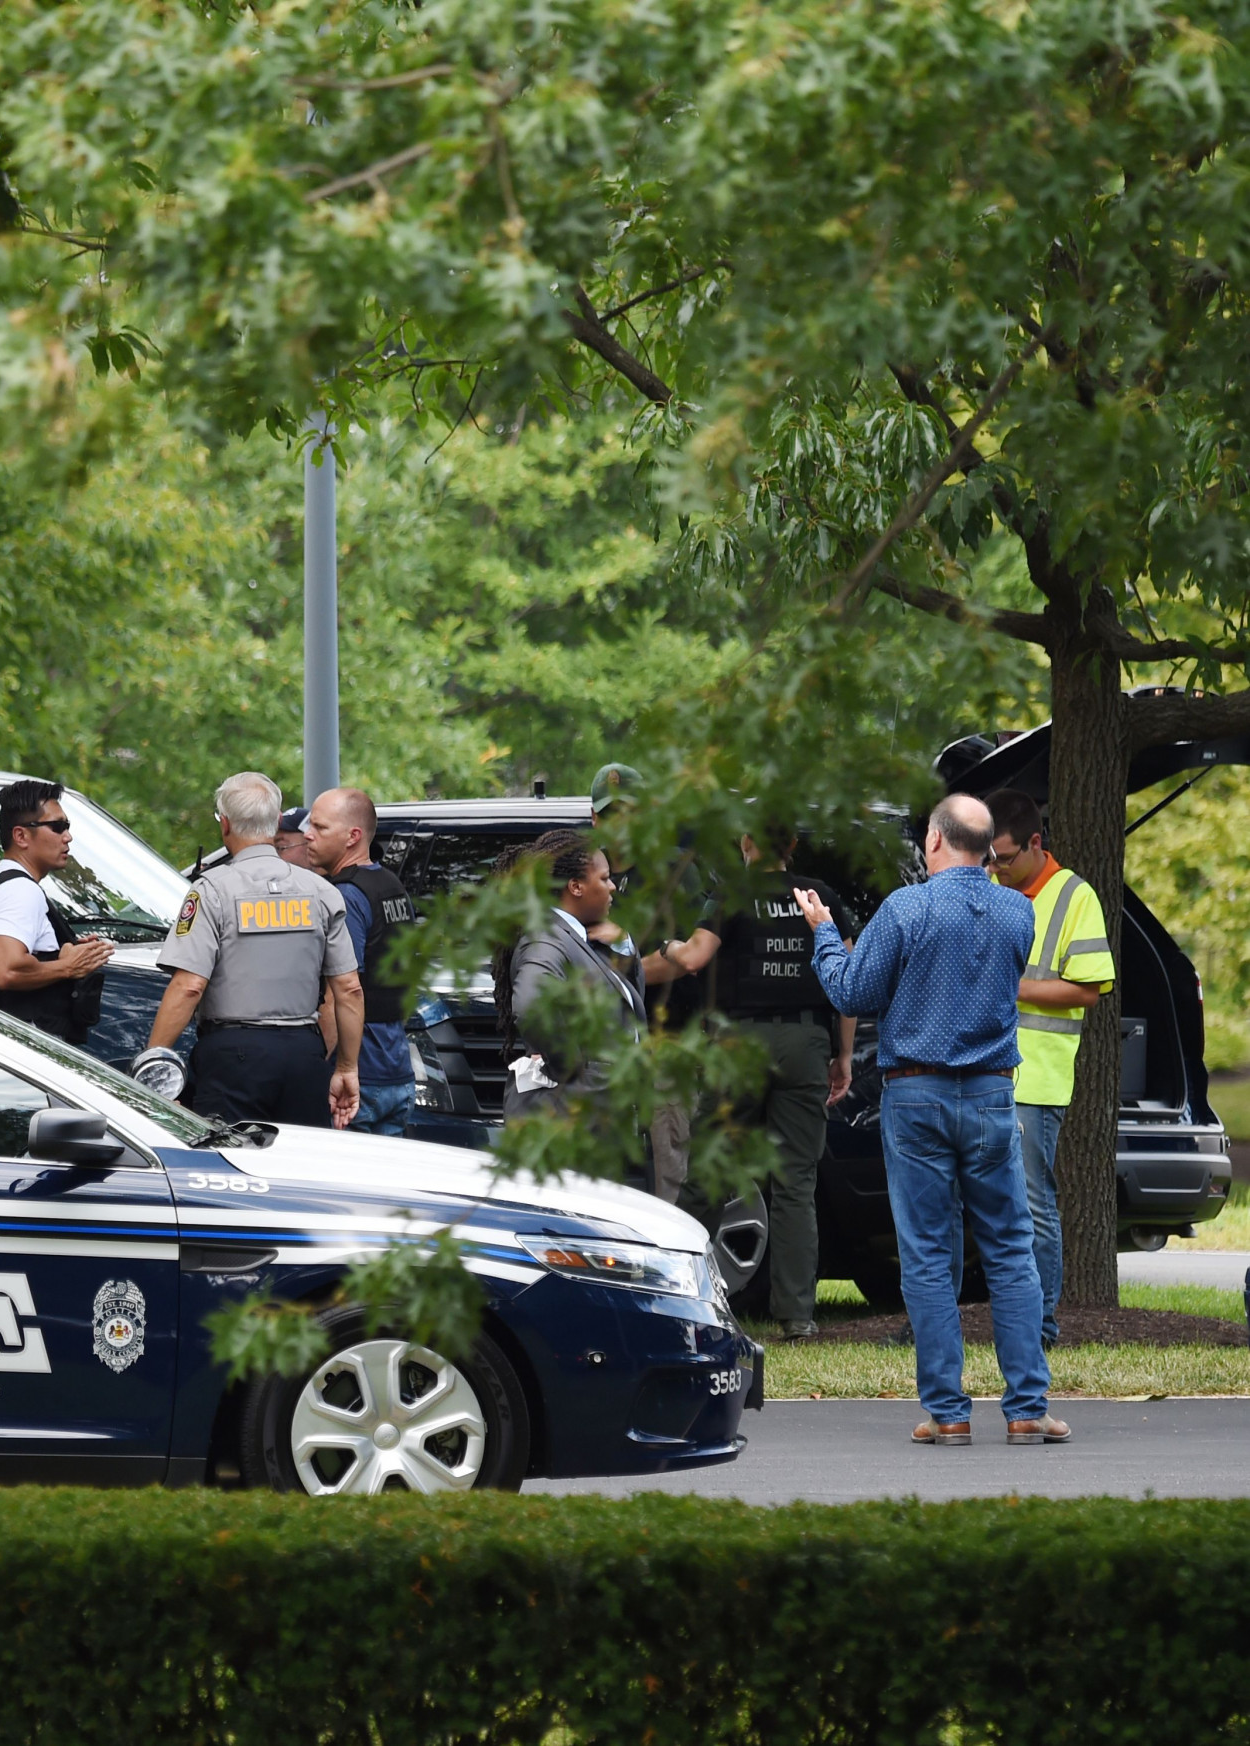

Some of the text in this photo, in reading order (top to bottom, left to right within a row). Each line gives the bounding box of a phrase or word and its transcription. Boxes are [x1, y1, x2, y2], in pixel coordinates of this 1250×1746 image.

[240, 899, 313, 929] POLICE
[382, 897, 411, 924] POLICE
[766, 938, 805, 953] POLICE
[762, 961, 801, 977] POLICE
[187, 1172, 270, 1193] 3583
[119, 1301, 135, 1309] 1940
[710, 1369, 742, 1396] 3583
